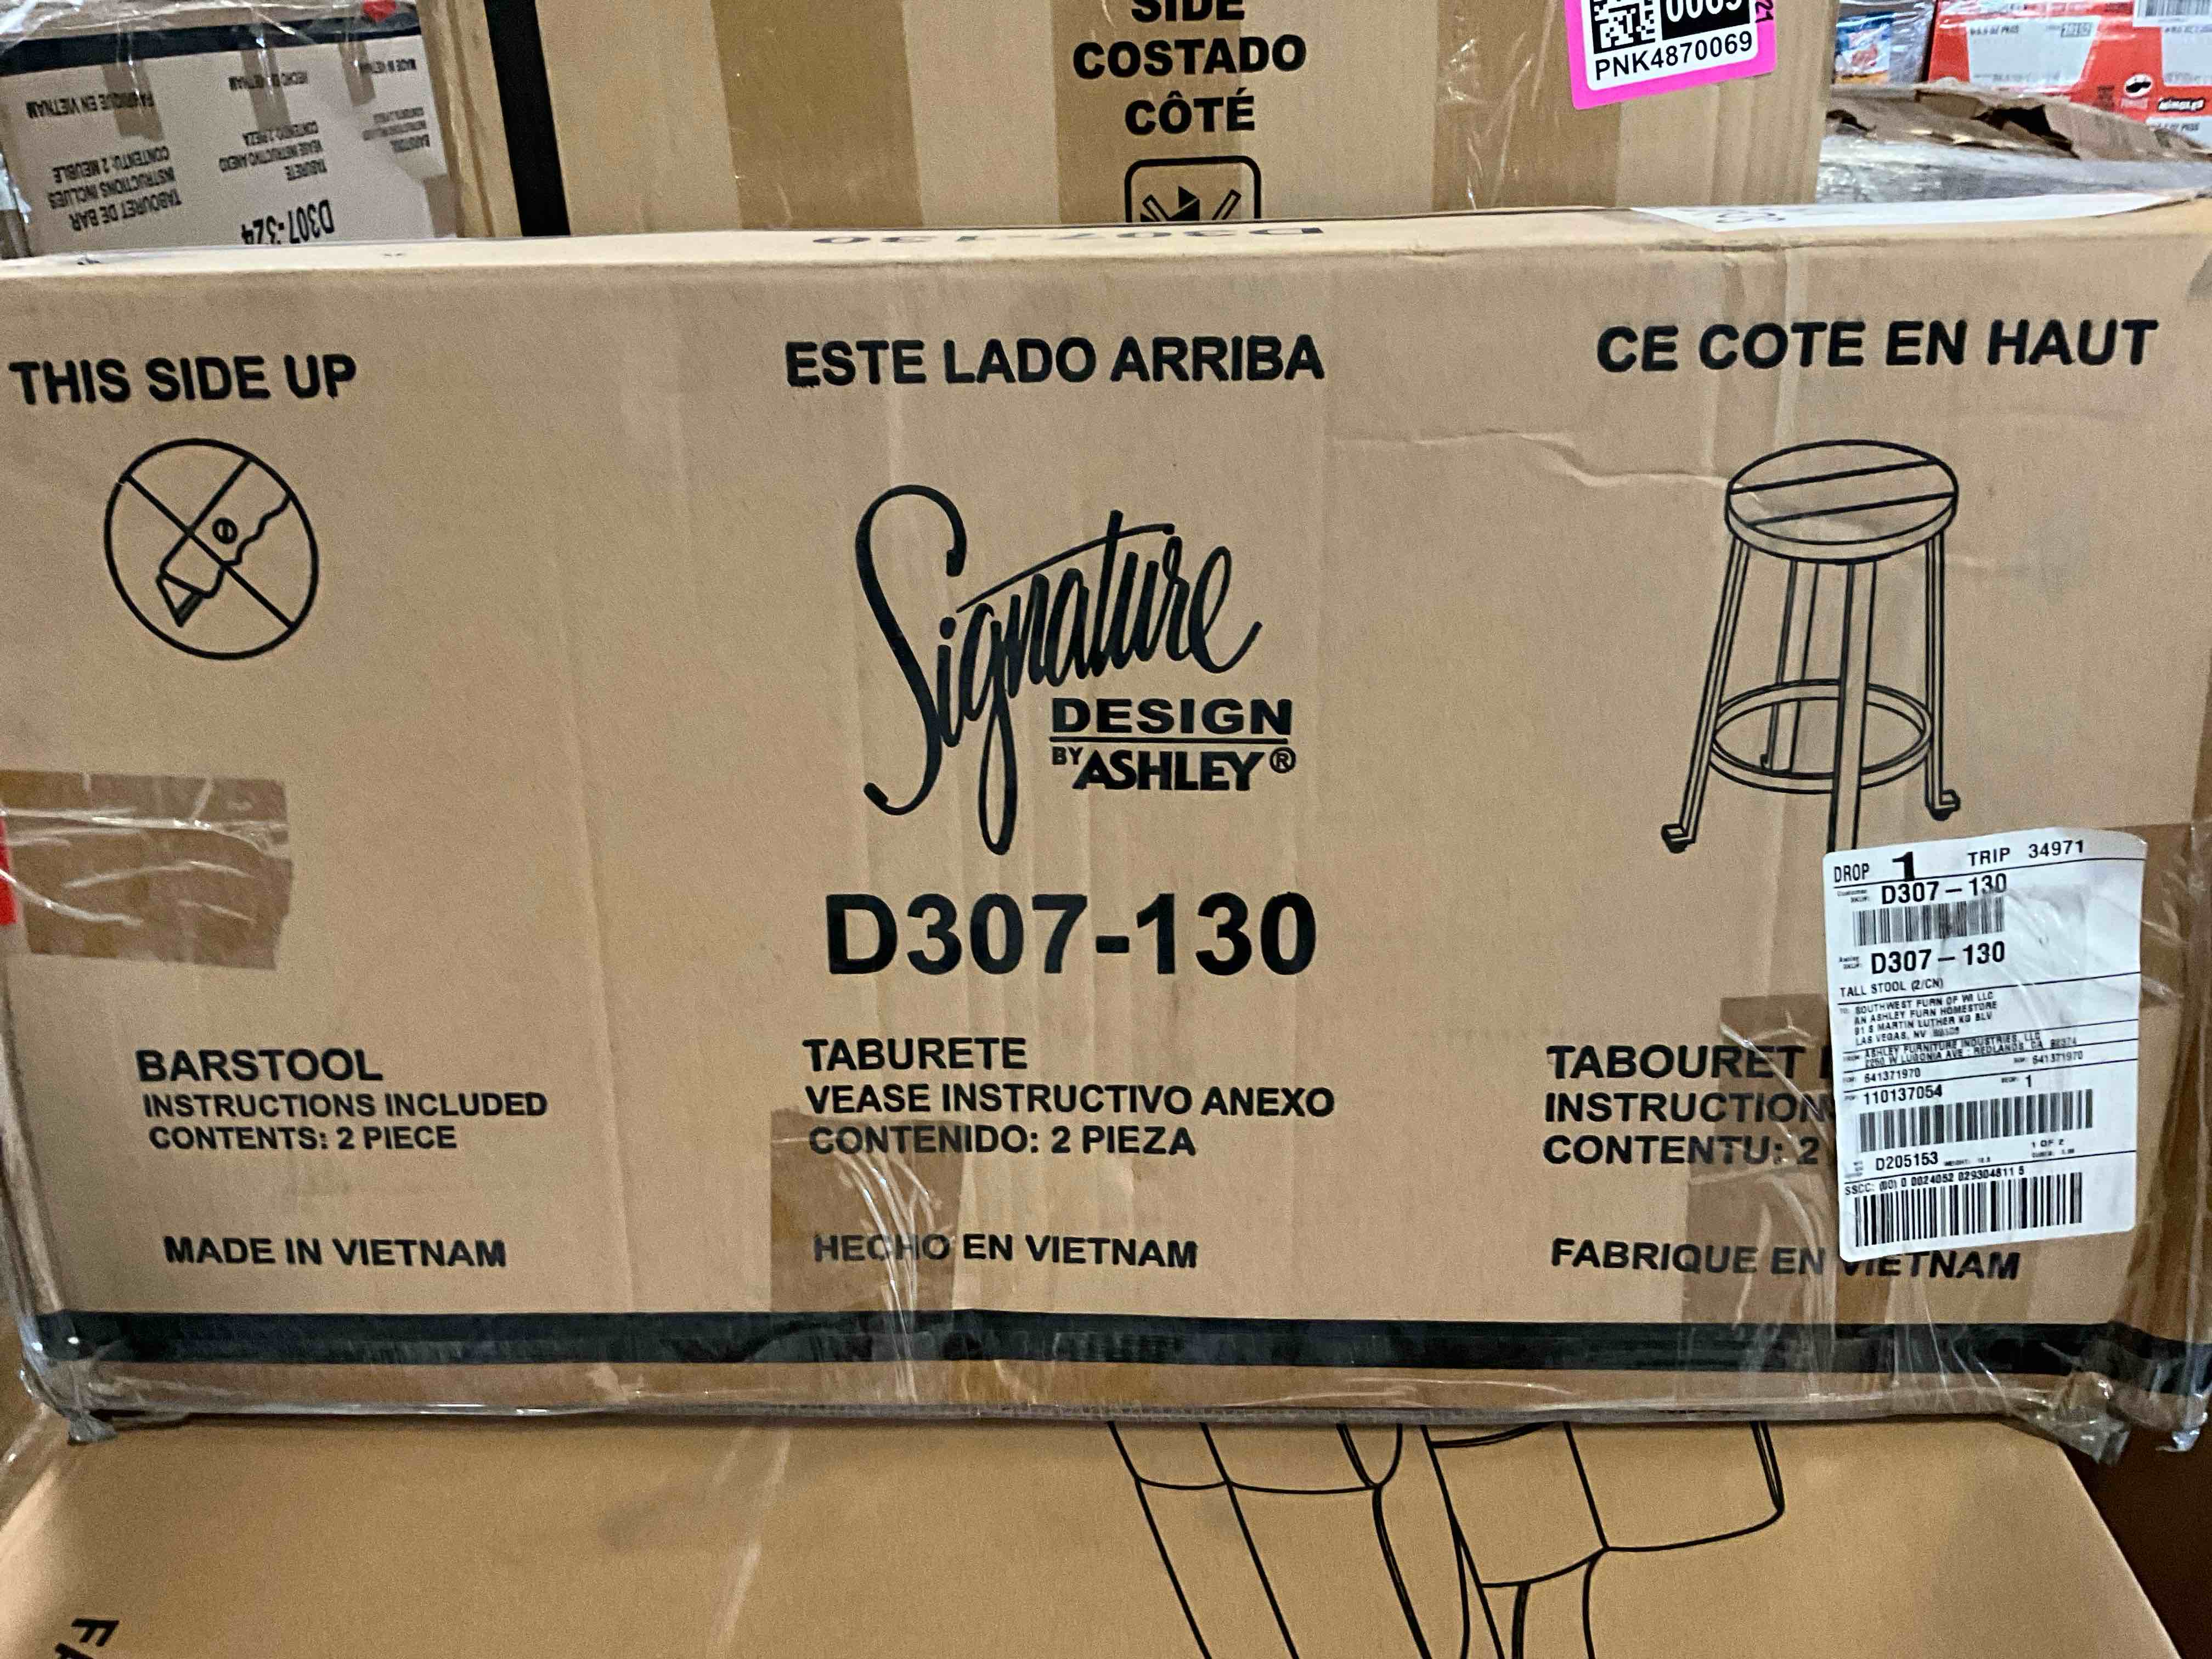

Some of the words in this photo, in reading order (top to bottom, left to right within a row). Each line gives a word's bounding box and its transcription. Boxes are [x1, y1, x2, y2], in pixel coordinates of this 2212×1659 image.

[1131, 0, 1245, 22] SIDE
[1073, 34, 1307, 80] COSTADO
[1595, 31, 1752, 81] PNK4870069
[26, 97, 81, 118] VIETNAM
[1125, 87, 1255, 136] CÔTÉ
[69, 209, 99, 231] BAR
[99, 205, 119, 223] DE
[122, 189, 182, 219] TABOURET
[786, 338, 927, 388] ESTE
[943, 336, 1097, 385] LADO
[1110, 334, 1325, 383] ARRIBA
[1596, 324, 1679, 373] CE
[1699, 320, 1866, 369] COTE
[1885, 319, 1968, 368] EN
[1986, 318, 2159, 366] HAUT
[8, 358, 131, 405] THIS
[145, 356, 271, 402] SIDE
[283, 354, 357, 400] UP
[855, 484, 1262, 855] Signature
[1051, 697, 1293, 735] DESIGN
[1051, 746, 1082, 765] BY
[1834, 863, 1870, 883] DROP
[1892, 851, 1915, 881] 1
[1968, 847, 2010, 866] TRIP
[2028, 839, 2084, 859] 34971
[825, 891, 1317, 975] D307-130
[1840, 986, 1866, 997] TALL
[1871, 981, 1906, 994] STOOL
[1911, 978, 1943, 991] (2/CN)
[1855, 1000, 1912, 1015] SOUTHWEST
[1916, 998, 1942, 1008] FURN
[1946, 996, 1958, 1004] OF
[1977, 991, 1993, 1001] LLC
[1854, 1016, 1866, 1025] AN
[1871, 1011, 1905, 1023] ASHLEY
[1910, 1008, 1936, 1018] FURN
[1940, 1001, 1997, 1015] HOMESTORE
[1868, 1025, 1874, 1033] S
[1877, 1020, 1914, 1031] MARTIN
[1918, 1017, 1955, 1028] LUTHER
[802, 1036, 1028, 1071] TABURETE
[1855, 1035, 1872, 1046] LAS
[1914, 1030, 1926, 1039] NV
[1865, 1046, 1899, 1058] ASHLEY
[1904, 1040, 1957, 1054] FURNITURE
[2024, 1032, 2040, 1041] LLC
[1947, 1049, 1963, 1059] AVE
[136, 1048, 383, 1082] BARSTOOL
[1546, 1043, 1807, 1080] TABOURET
[1864, 1068, 1921, 1084] 641371970
[144, 1093, 376, 1119] INSTRUCTIONS
[385, 1091, 548, 1117] INCLUDED
[804, 1082, 931, 1114] VEASE
[942, 1081, 1193, 1115] INSTRUCTIVO
[1200, 1086, 1335, 1118] ANEXO
[1864, 1084, 1943, 1105] 110137054
[2025, 1074, 2032, 1087] 1
[1544, 1091, 1836, 1124] INSTRUCTION
[148, 1126, 328, 1152] CONTENTS:
[336, 1126, 355, 1151] 2
[364, 1125, 458, 1150] PIECE
[809, 1124, 1039, 1155] CONTENIDO:
[1051, 1124, 1071, 1154] 2
[1082, 1125, 1197, 1156] PIEZA
[1543, 1134, 1783, 1165] CONTENTU:
[1797, 1136, 1820, 1166] 2
[1876, 1151, 1938, 1171] D205153
[1844, 1182, 1875, 1195] SSCC:
[1900, 1178, 1907, 1187] 0
[1911, 1172, 1954, 1186] 0024052
[2018, 1166, 2025, 1175] 5
[163, 1235, 276, 1266] MADE
[285, 1238, 323, 1266] IN
[332, 1238, 507, 1268] VIETNAM
[814, 1233, 951, 1262] HECHO
[962, 1233, 1013, 1262] EN
[1025, 1234, 1198, 1269] VIETNAM
[1551, 1238, 1759, 1274] FABRIQUE
[1770, 1246, 1827, 1276] EN
